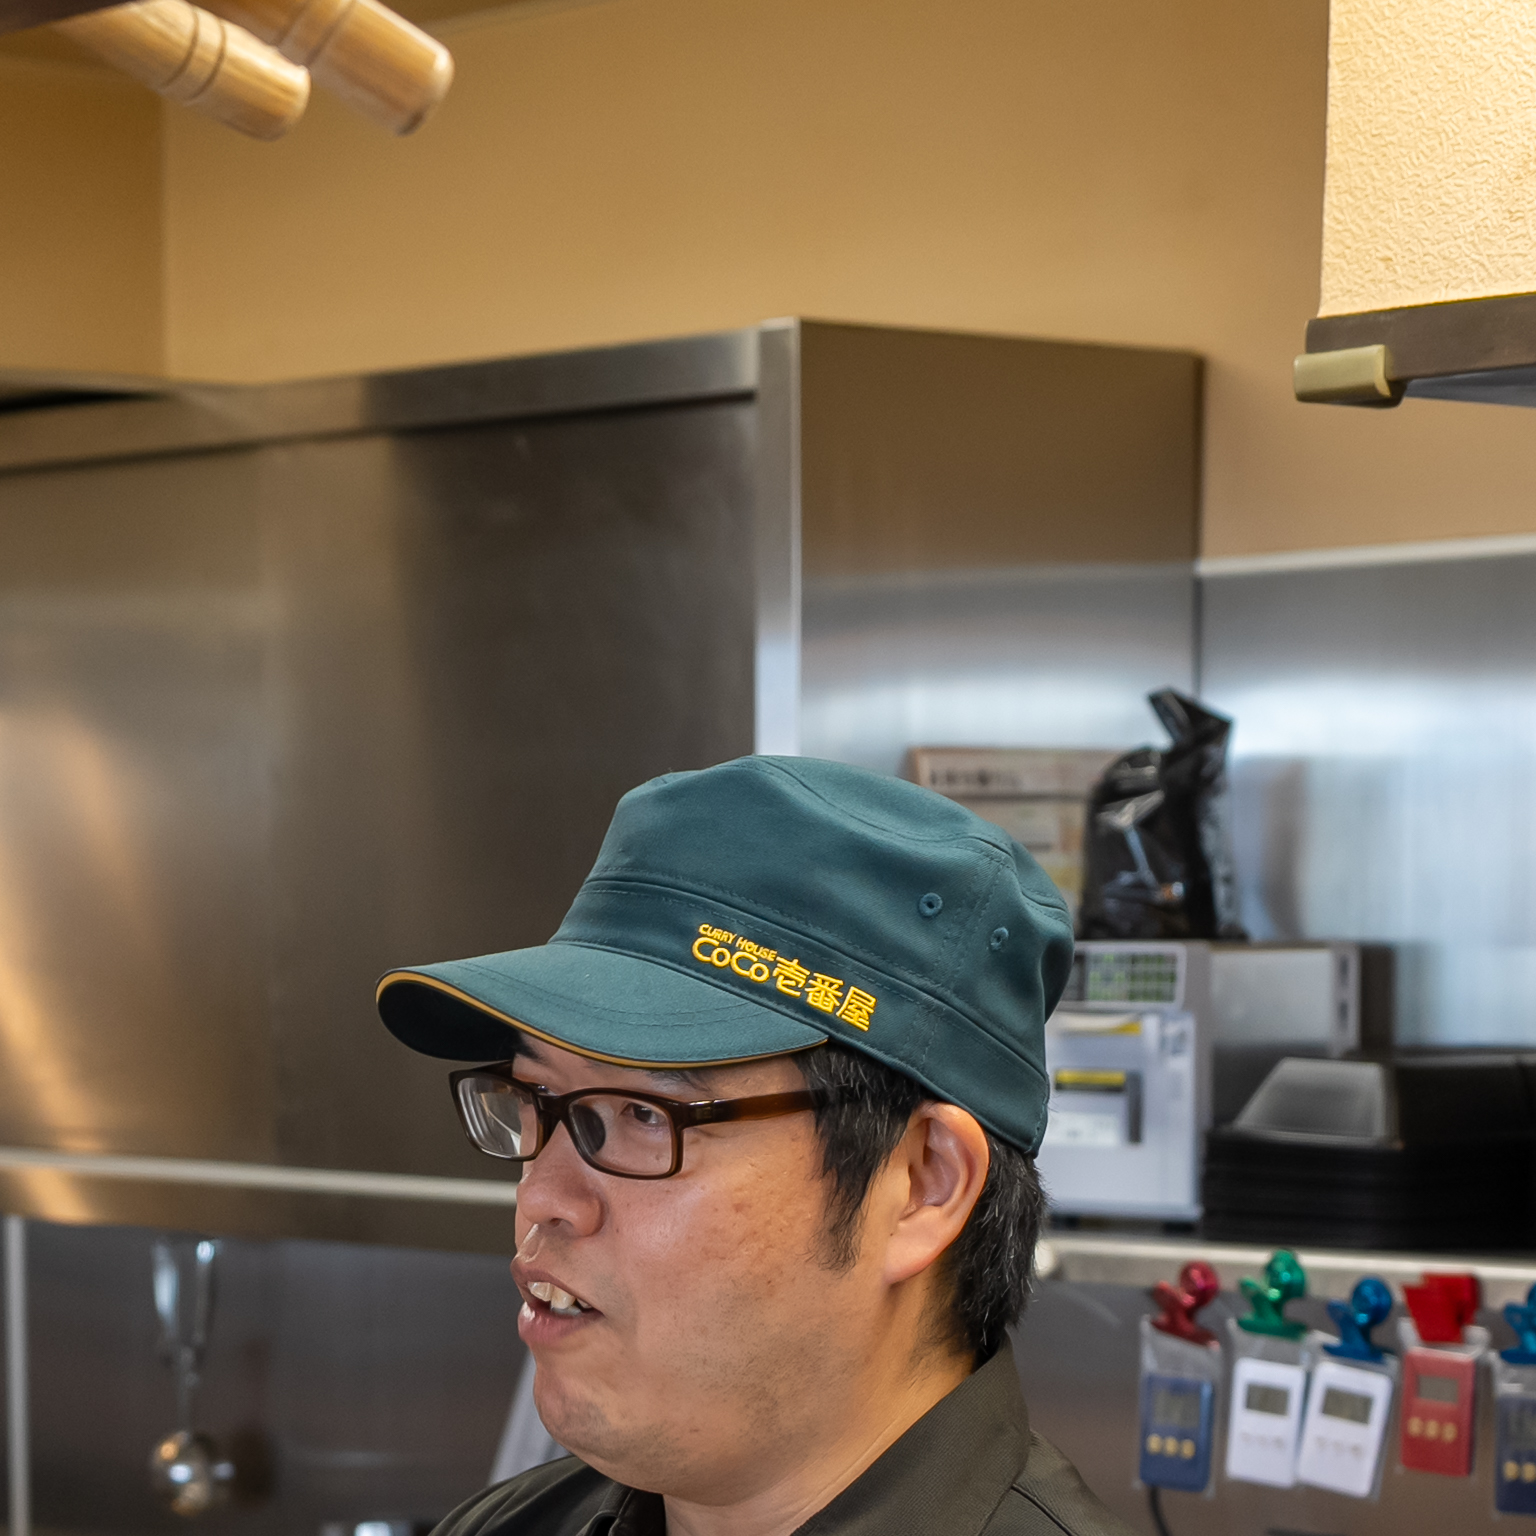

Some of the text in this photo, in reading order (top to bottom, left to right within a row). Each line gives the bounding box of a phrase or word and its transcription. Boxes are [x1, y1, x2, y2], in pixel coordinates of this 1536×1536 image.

[698, 923, 778, 962] CURRY HOUSE
[692, 936, 877, 1032] CoCo壱番屋
